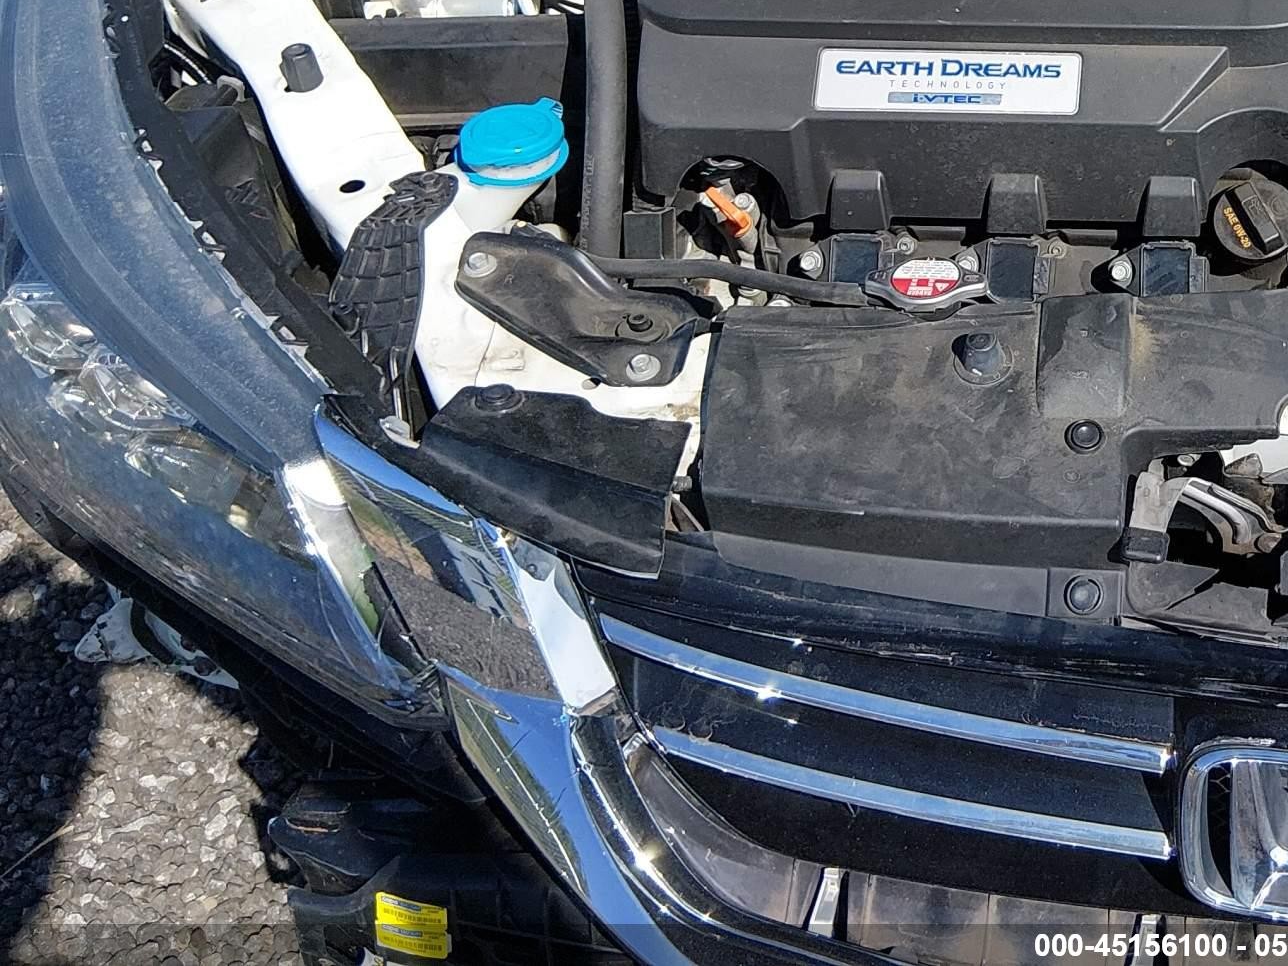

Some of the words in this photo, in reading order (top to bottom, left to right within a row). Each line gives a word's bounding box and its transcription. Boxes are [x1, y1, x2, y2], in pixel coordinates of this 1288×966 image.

[836, 60, 934, 77] EARTH
[940, 59, 1062, 78] DREAMS
[889, 80, 1006, 90] TECHNOLOGY
[1223, 207, 1240, 225] SAE
